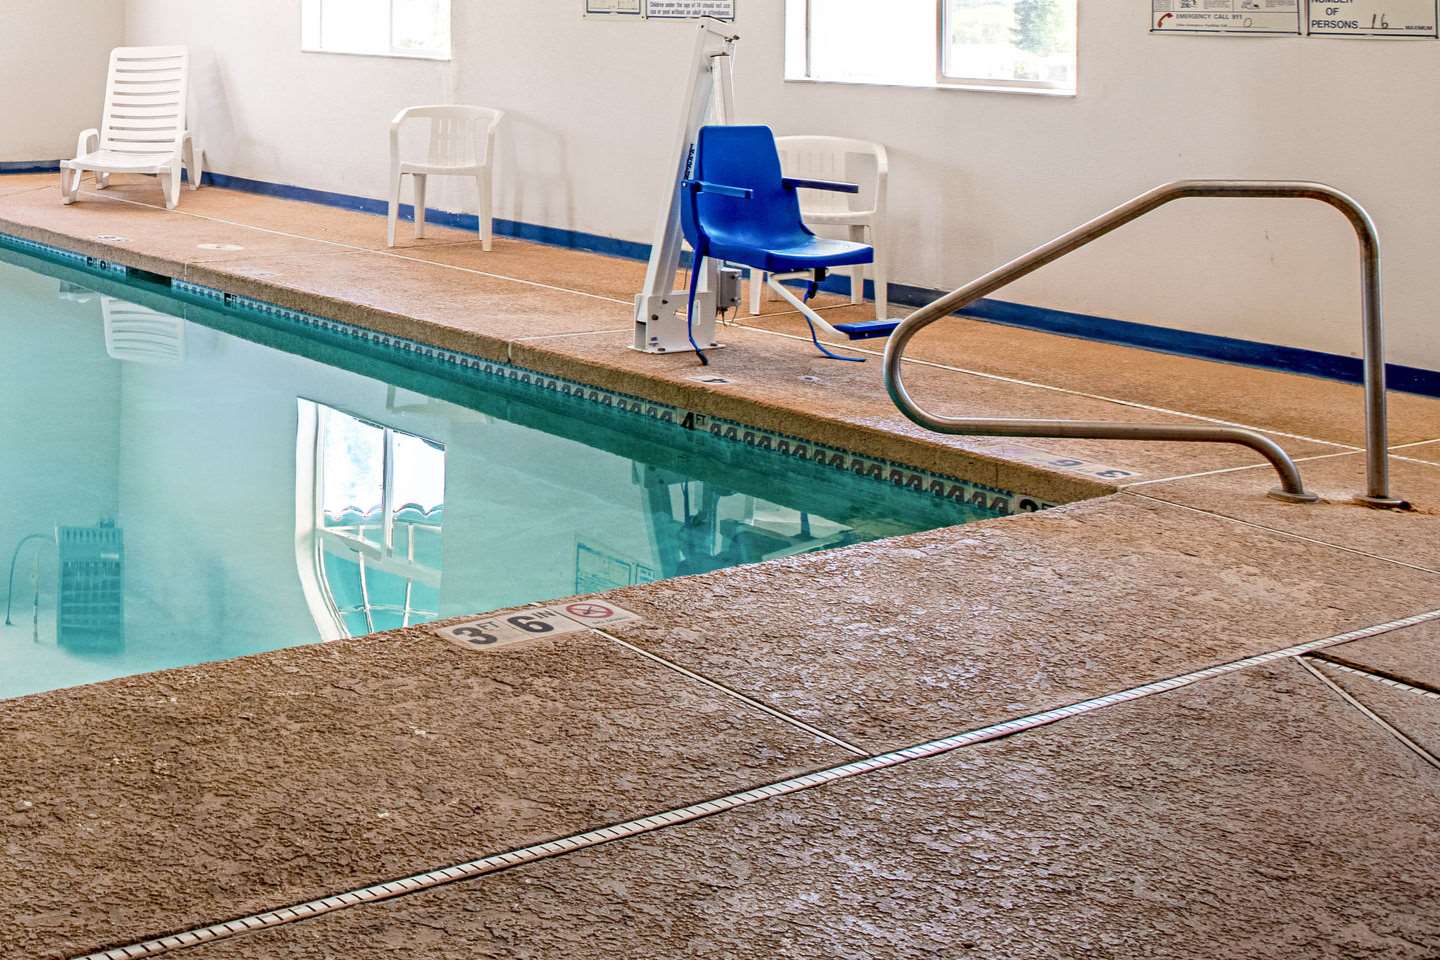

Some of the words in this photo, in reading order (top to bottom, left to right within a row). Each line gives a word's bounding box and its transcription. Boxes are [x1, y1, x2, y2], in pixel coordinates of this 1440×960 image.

[1326, 8, 1339, 16] OF
[1311, 20, 1359, 29] PERSONS
[1372, 13, 1388, 29] 16
[681, 412, 694, 430] 4
[696, 414, 706, 425] FT
[508, 615, 554, 633] 6
[532, 610, 556, 620] IN
[453, 626, 498, 644] 3
[478, 620, 500, 631] FT
